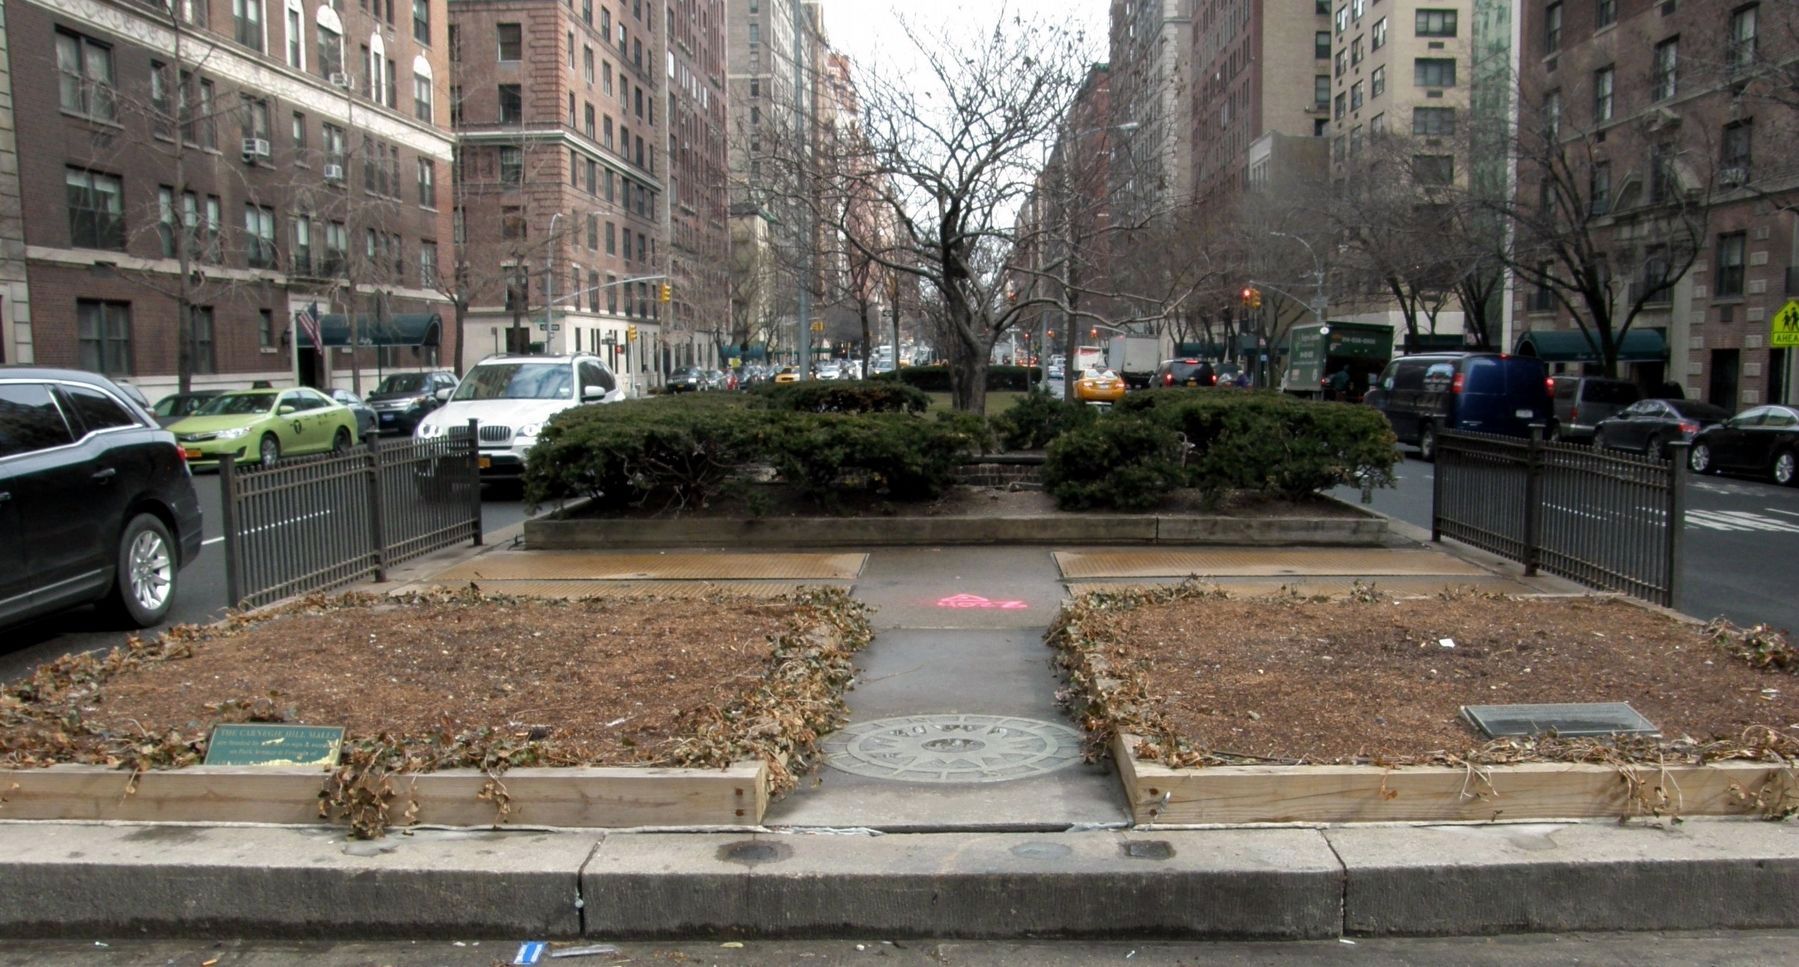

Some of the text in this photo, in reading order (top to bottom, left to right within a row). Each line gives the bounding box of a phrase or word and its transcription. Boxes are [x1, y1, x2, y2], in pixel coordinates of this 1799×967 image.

[1776, 334, 1799, 342] AHEA
[220, 729, 338, 739] THE CARNEGIE HILL MALLS
